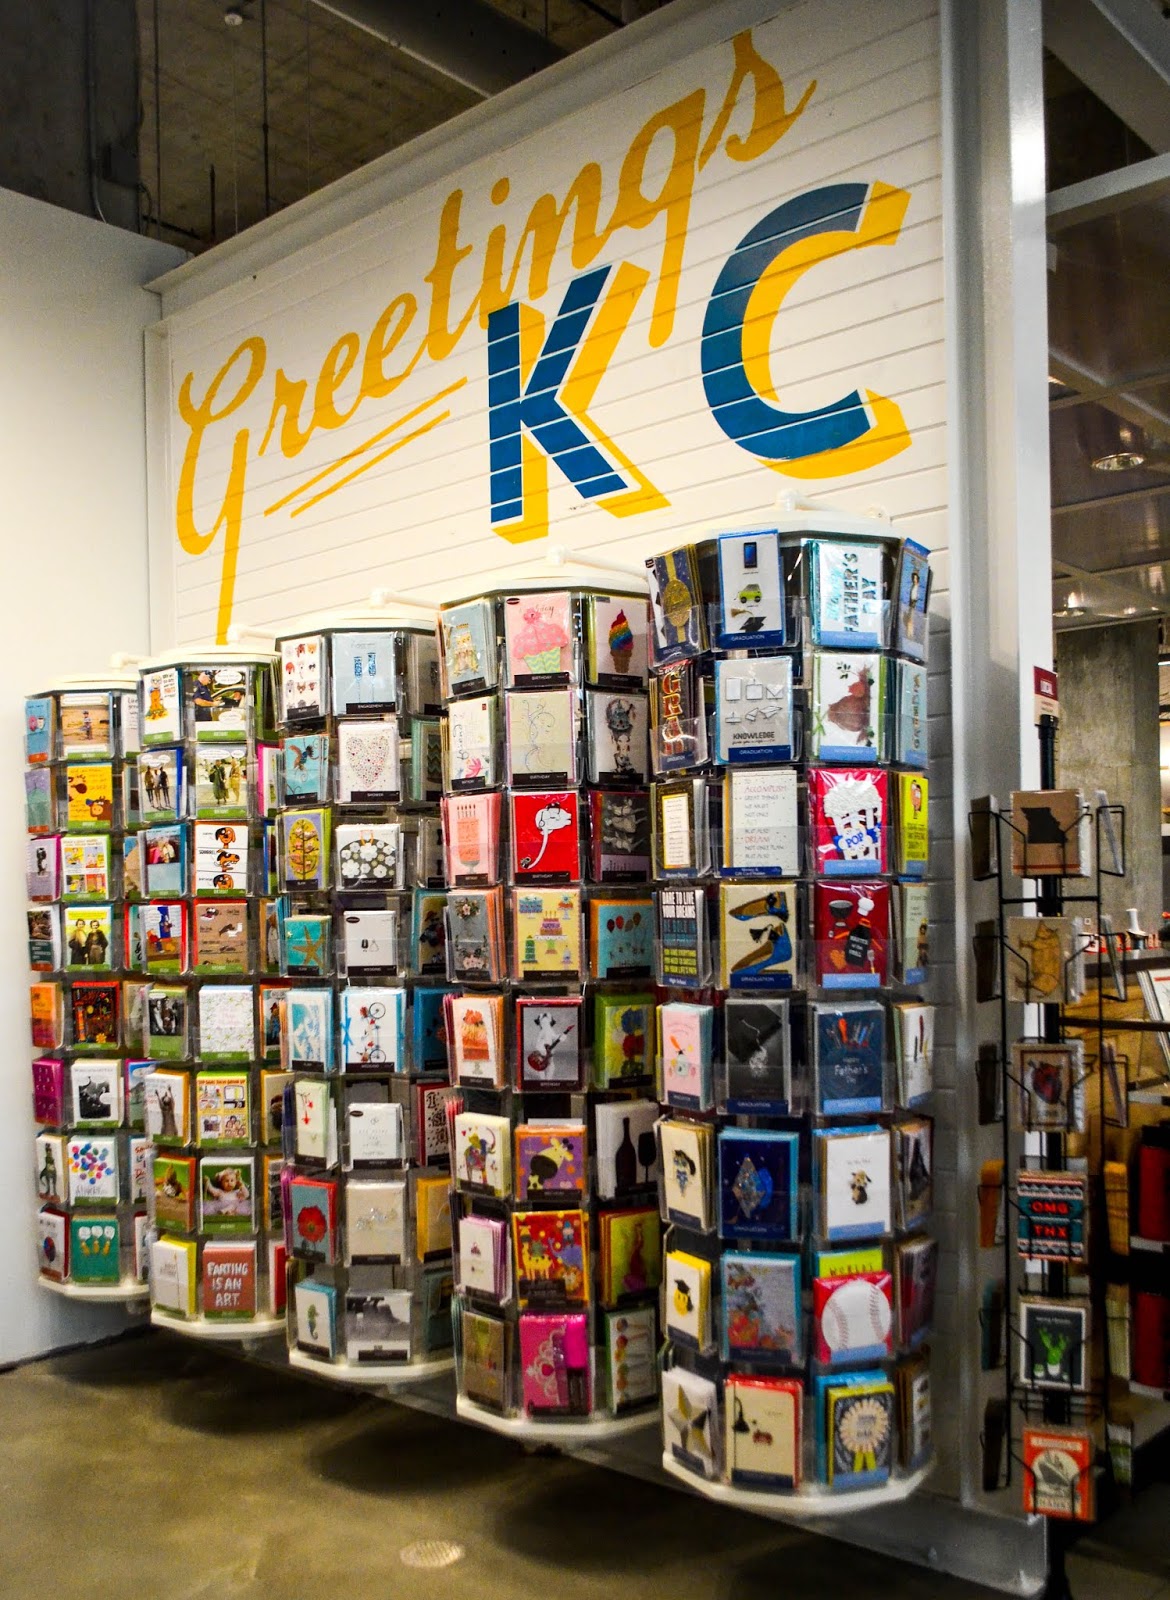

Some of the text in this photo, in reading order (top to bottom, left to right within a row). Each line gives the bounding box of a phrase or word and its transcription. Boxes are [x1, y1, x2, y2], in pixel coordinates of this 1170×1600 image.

[177, 29, 818, 645] Greetings
[843, 553, 859, 633] FATHER'S
[731, 634, 765, 643] GRADUATION
[733, 731, 775, 741] KNOWLEDGE
[739, 748, 774, 757] GRADUATION
[845, 832, 864, 849] POP
[1031, 1200, 1069, 1215] OMG
[1034, 1224, 1067, 1239] THX
[207, 1261, 248, 1277] FARTING
[212, 1278, 242, 1290] IS AN
